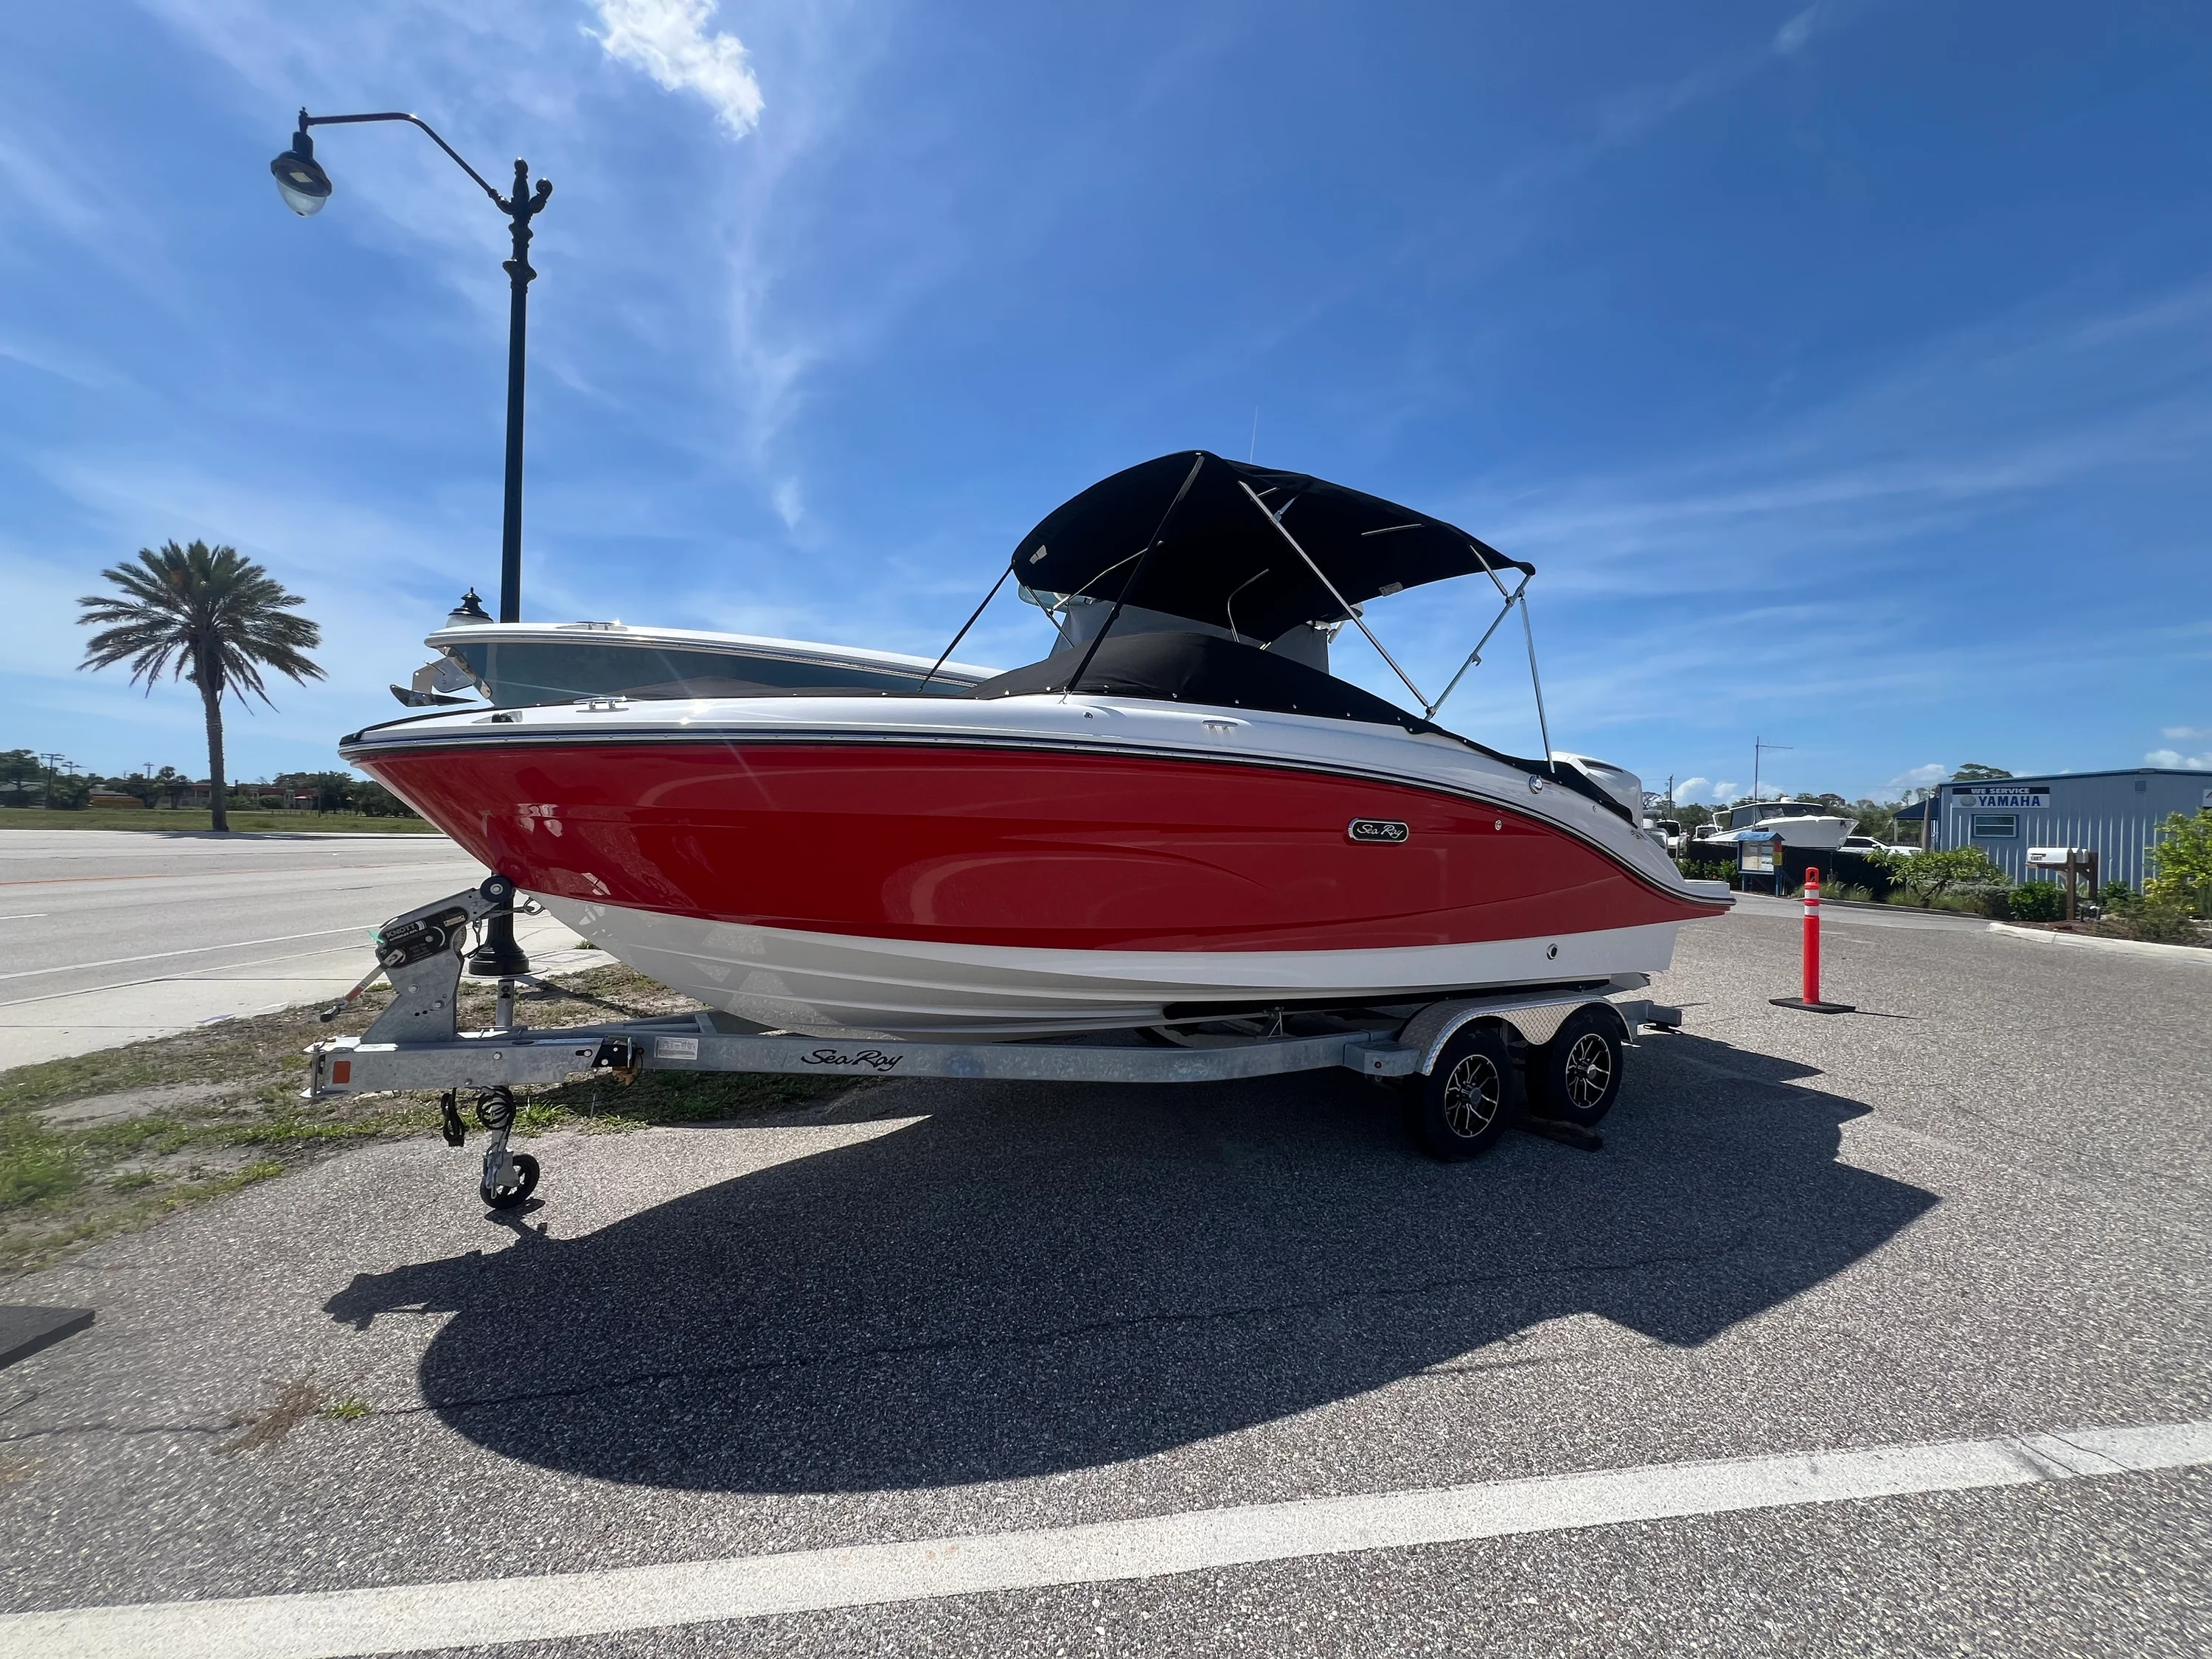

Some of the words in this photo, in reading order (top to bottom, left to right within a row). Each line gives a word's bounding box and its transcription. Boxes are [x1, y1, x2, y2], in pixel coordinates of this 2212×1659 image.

[1978, 796, 2041, 807] YAMAHA
[1357, 824, 1379, 835] Sea
[1380, 824, 1404, 838] Ray
[386, 923, 416, 939] KNOTT
[800, 1049, 853, 1065] Sea
[852, 1050, 904, 1071] Ray
